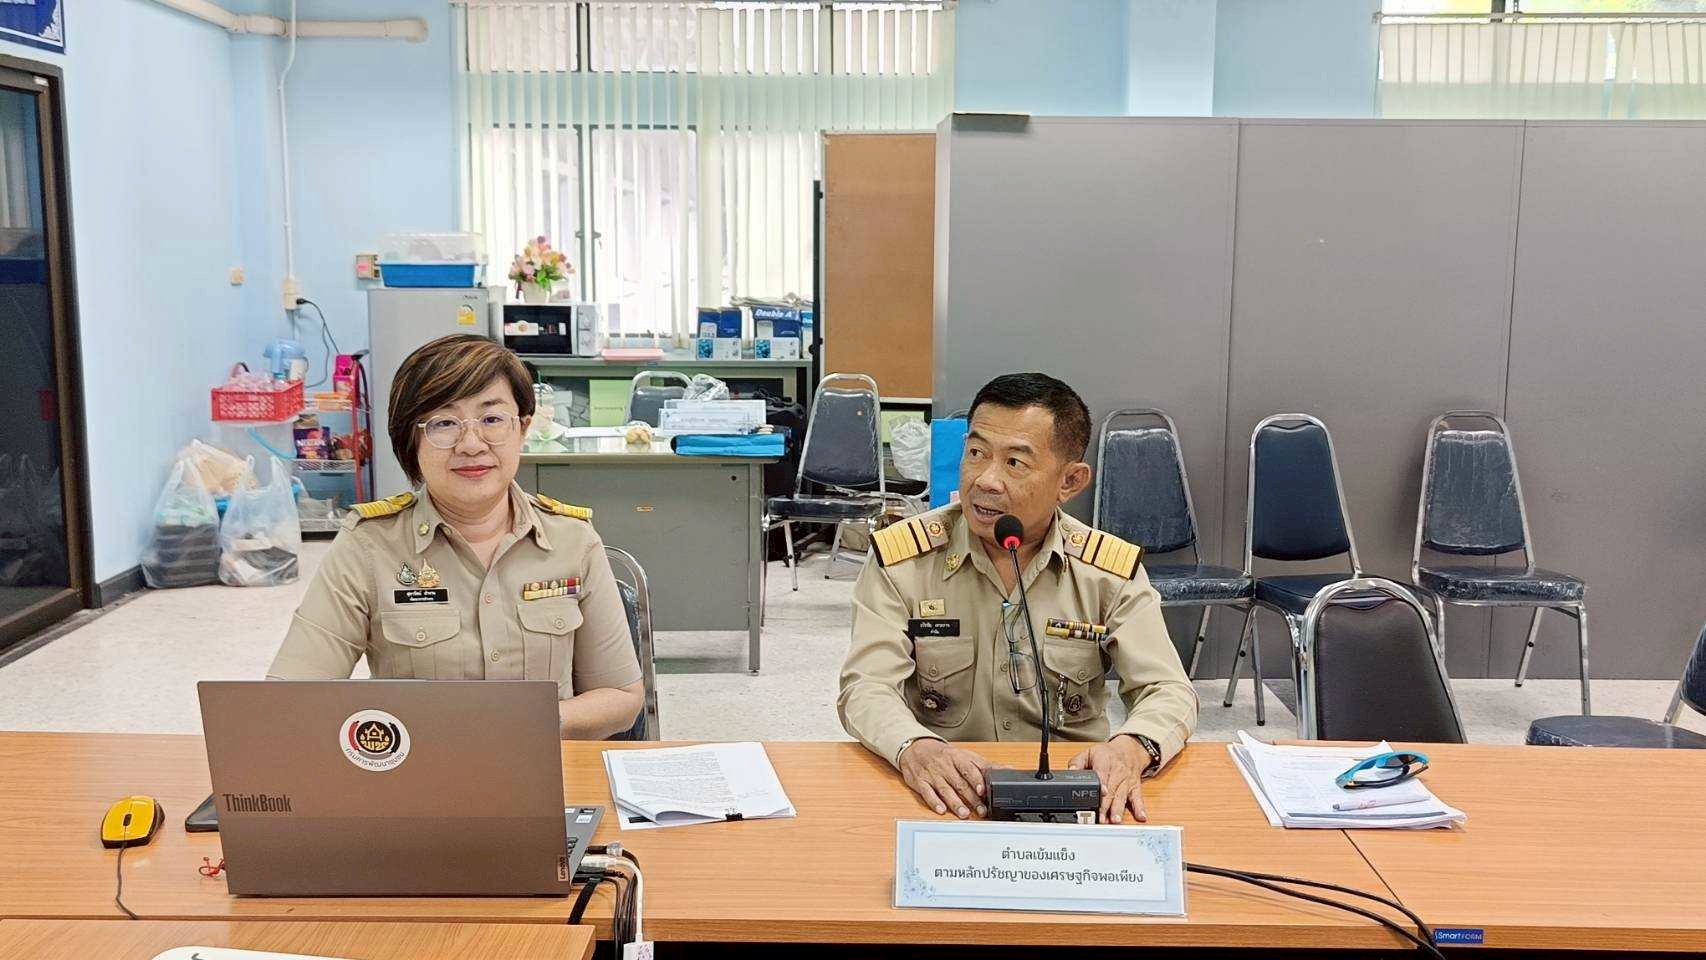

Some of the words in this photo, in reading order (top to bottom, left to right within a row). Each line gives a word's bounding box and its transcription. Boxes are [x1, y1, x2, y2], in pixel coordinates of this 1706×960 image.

[754, 308, 784, 318] Double
[222, 793, 293, 813] ThinkBook
[1001, 845, 1076, 862] ตำบลเข้มแข็ง
[933, 865, 1144, 885] ตามหลักปรัชญาของเศรษฐกิจพอเพียง
